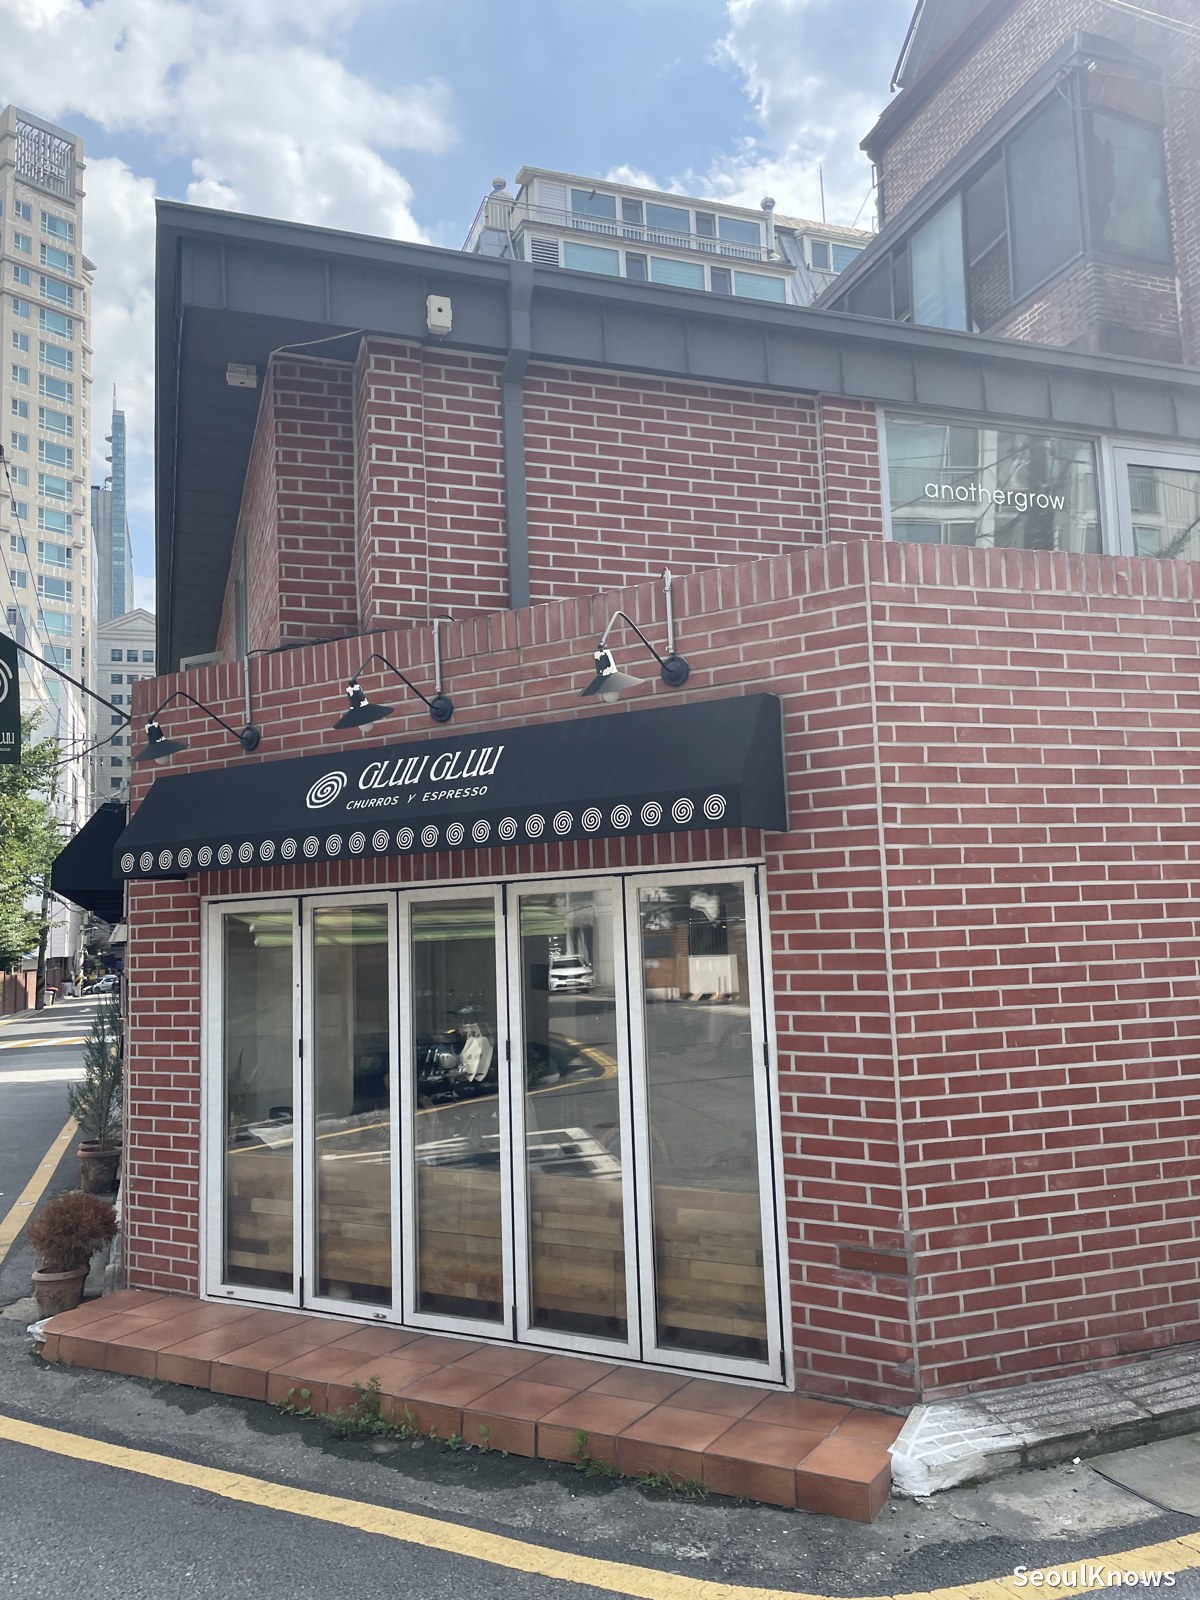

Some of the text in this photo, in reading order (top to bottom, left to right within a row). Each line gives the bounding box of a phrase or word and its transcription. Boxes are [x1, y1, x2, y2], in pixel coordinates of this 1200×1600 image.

[924, 482, 1065, 512] anothergrow
[359, 745, 505, 790] GLUU GLUU
[346, 785, 488, 810] CHURROS Y ESPRESSO
